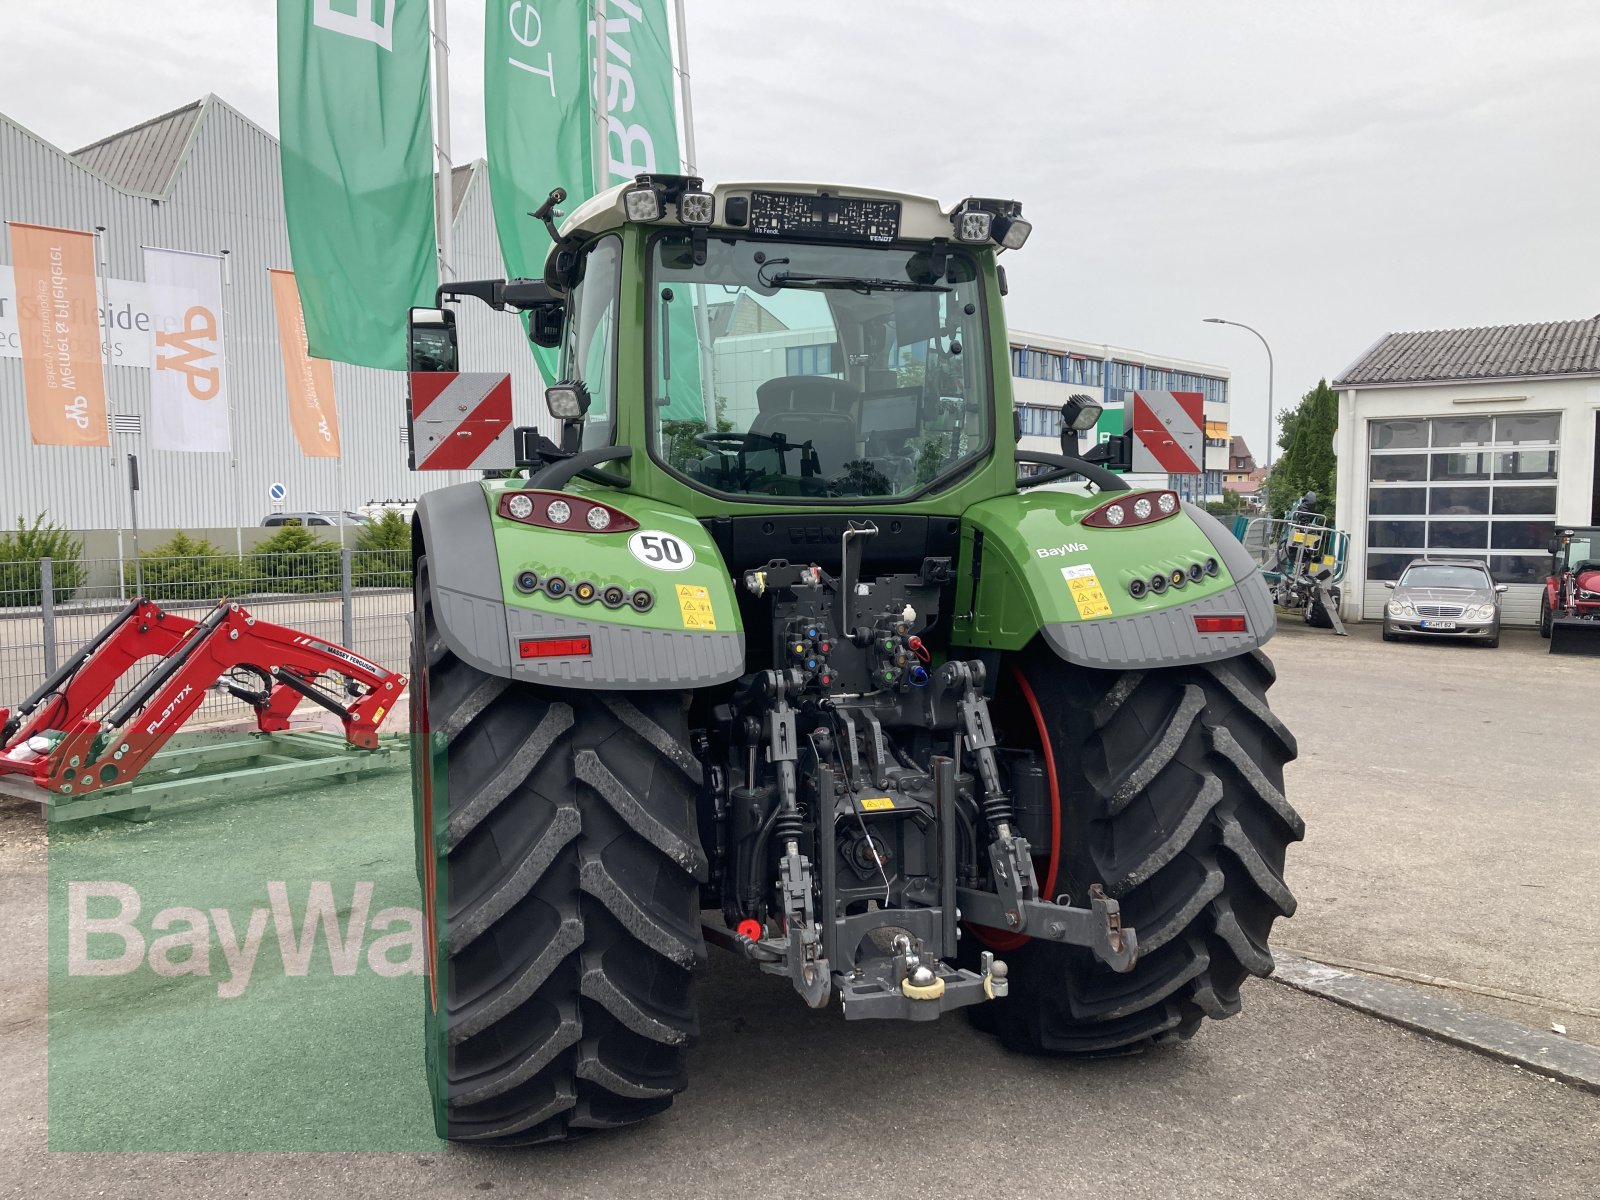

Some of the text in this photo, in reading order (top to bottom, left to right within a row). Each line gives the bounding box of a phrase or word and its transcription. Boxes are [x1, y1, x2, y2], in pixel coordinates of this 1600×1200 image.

[640, 536, 683, 563] 50
[1036, 542, 1089, 558] BayWa
[327, 646, 376, 673] MASSEY FERGUSON
